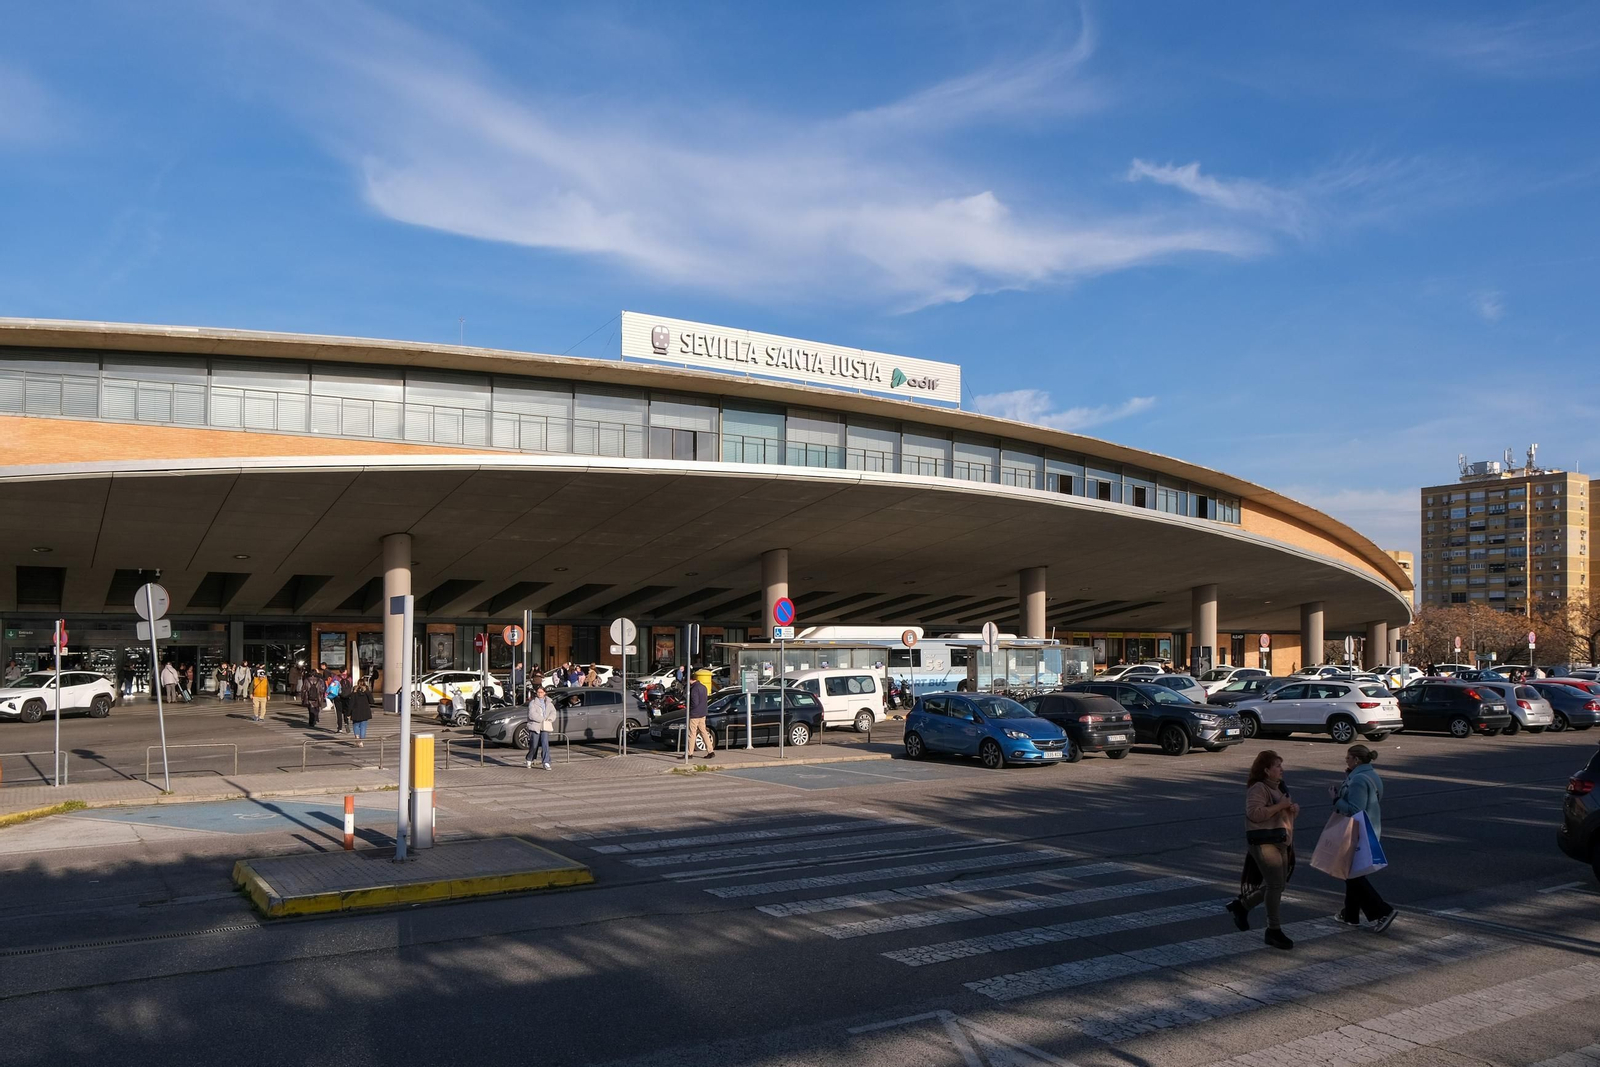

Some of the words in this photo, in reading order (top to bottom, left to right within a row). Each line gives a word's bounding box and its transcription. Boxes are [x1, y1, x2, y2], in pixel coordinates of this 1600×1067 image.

[680, 331, 758, 364] SEVILLA
[765, 345, 825, 374] SANTA
[830, 354, 882, 382] JUSTA
[907, 376, 940, 390] adif
[928, 678, 948, 687] BUS
